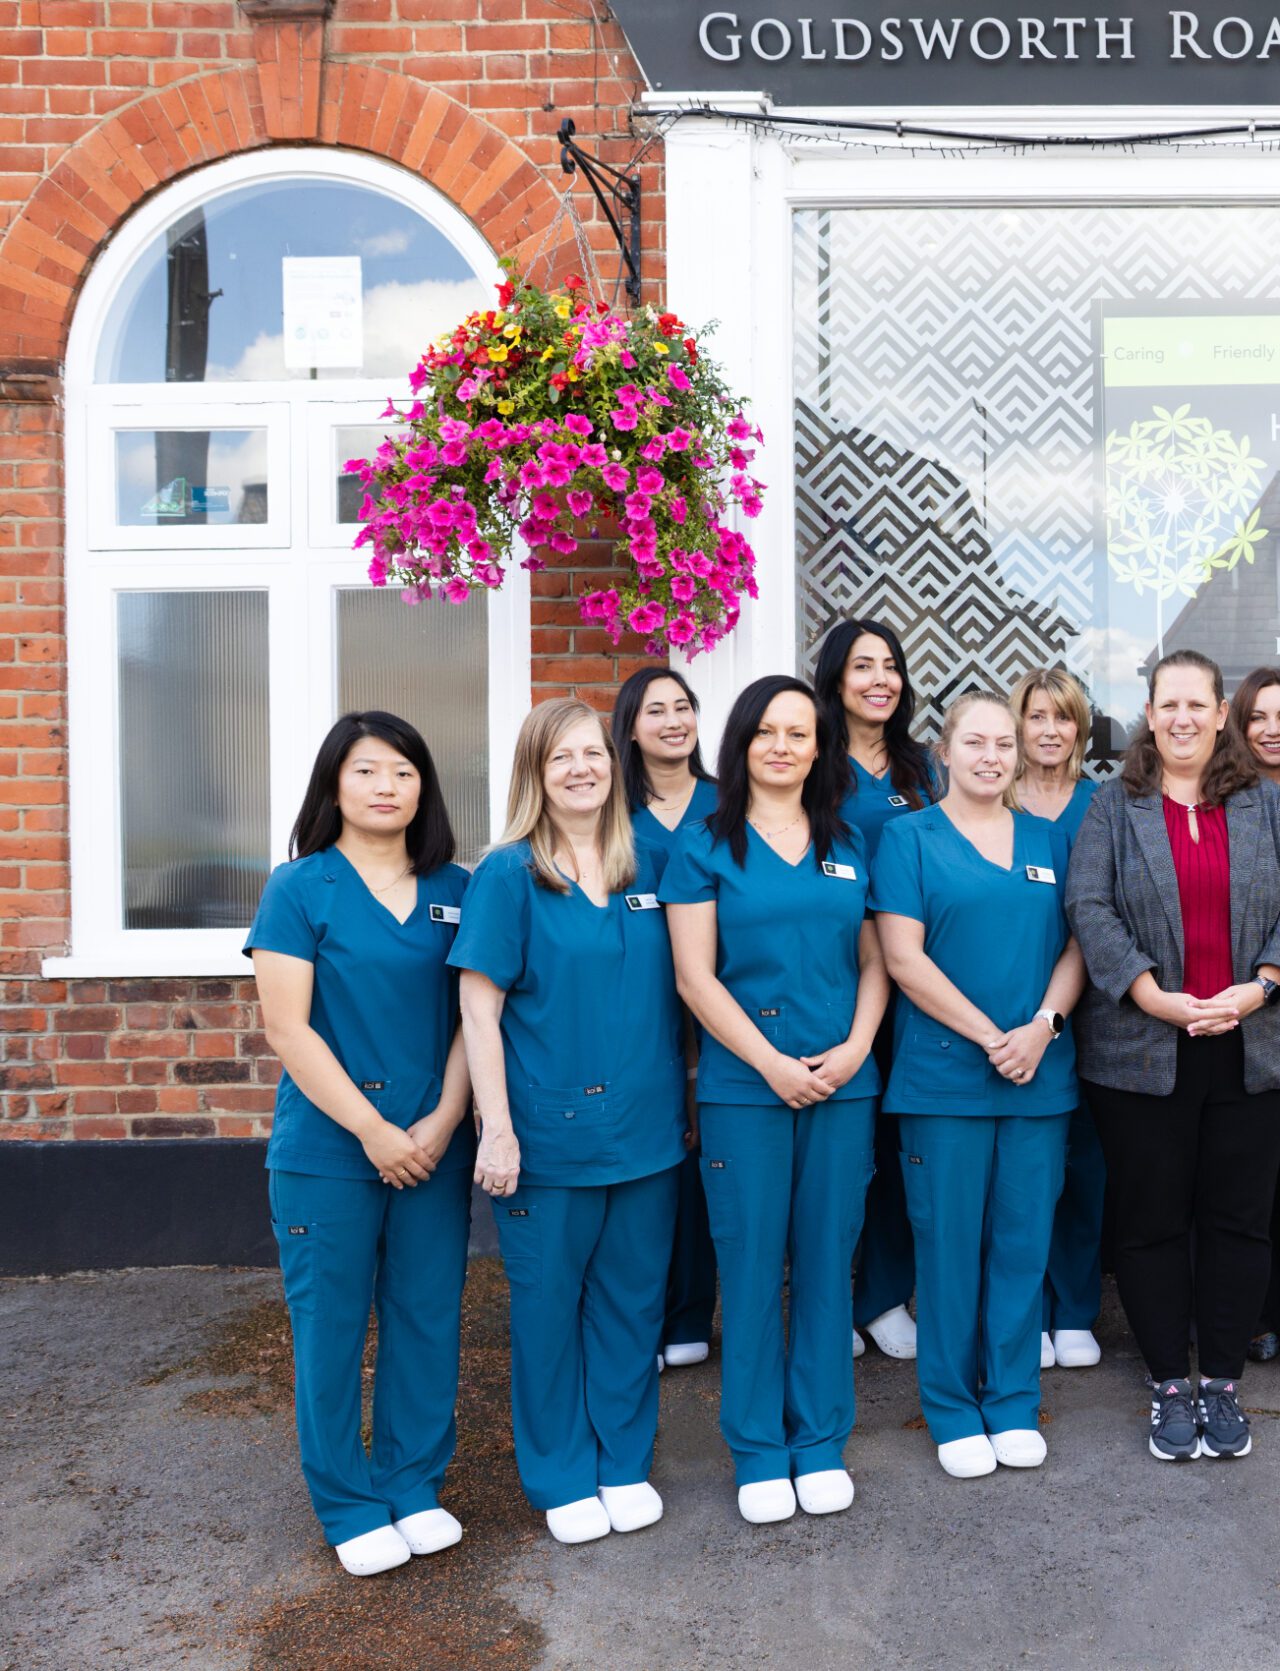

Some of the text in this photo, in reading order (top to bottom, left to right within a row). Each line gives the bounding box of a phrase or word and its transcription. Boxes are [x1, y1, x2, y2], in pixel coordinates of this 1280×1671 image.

[698, 11, 1137, 62] GOLDSWORTH
[1113, 346, 1165, 363] Caring
[1213, 344, 1276, 361] Friendly
